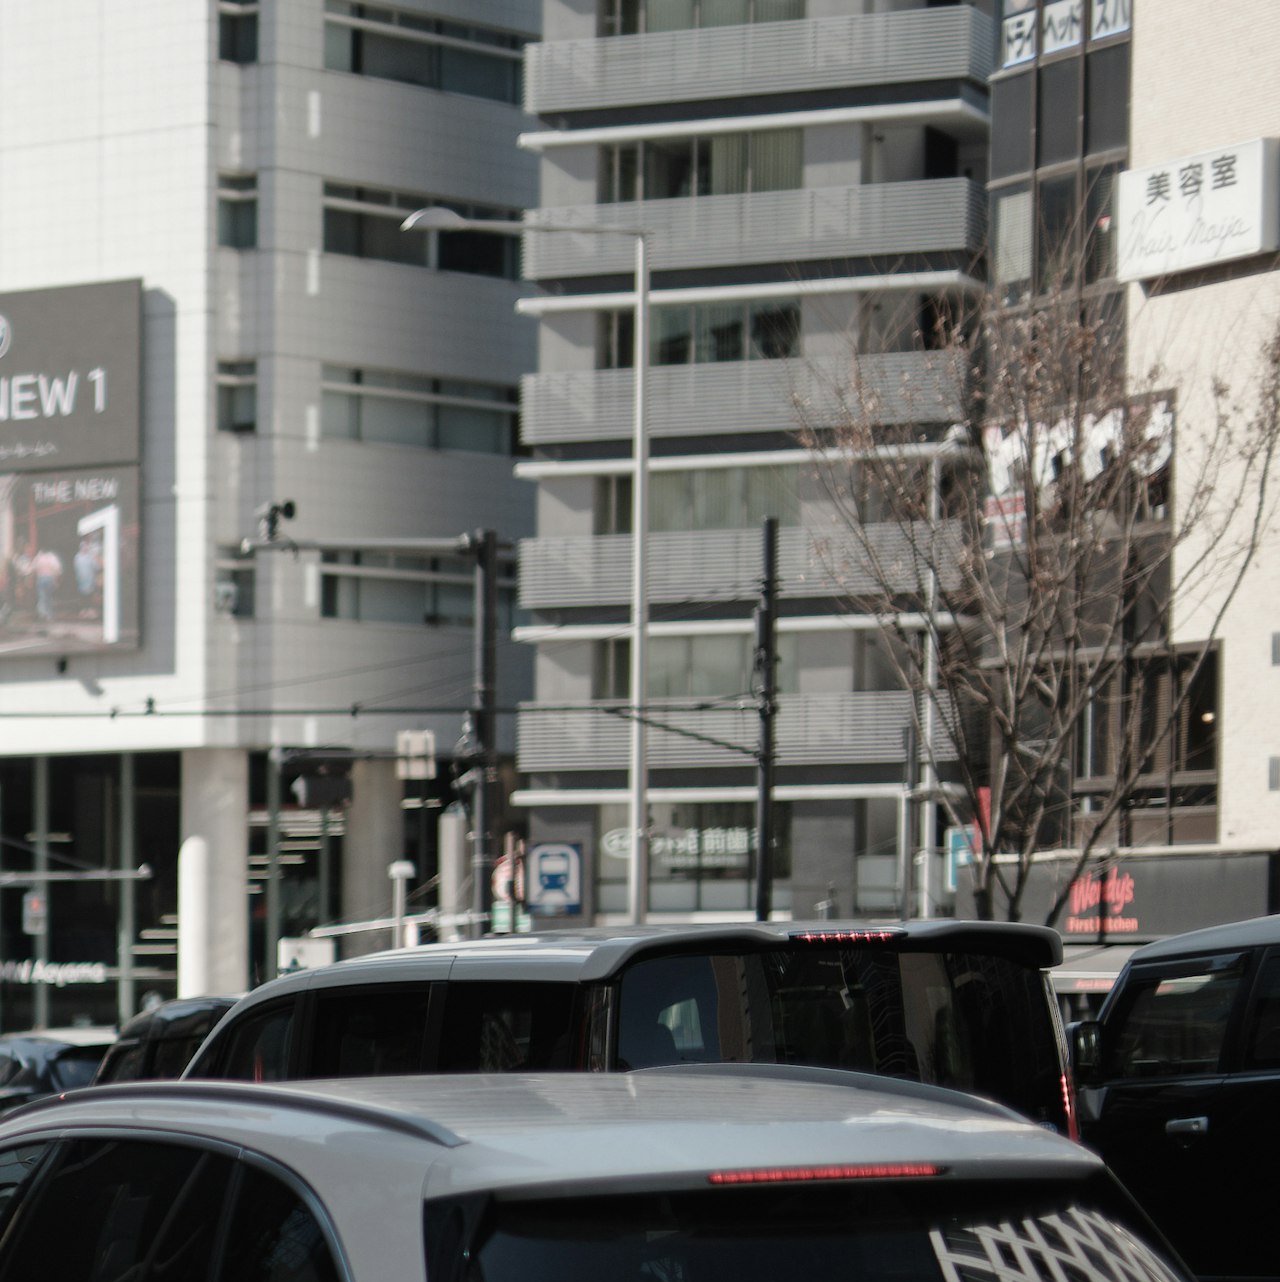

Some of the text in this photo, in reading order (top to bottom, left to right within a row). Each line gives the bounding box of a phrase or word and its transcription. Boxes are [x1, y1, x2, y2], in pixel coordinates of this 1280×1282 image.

[1146, 153, 1239, 206] 美容室
[86, 365, 107, 414] 1
[32, 477, 119, 503] THE NEW
[76, 503, 119, 645] 1
[32, 959, 106, 988] Aoyama
